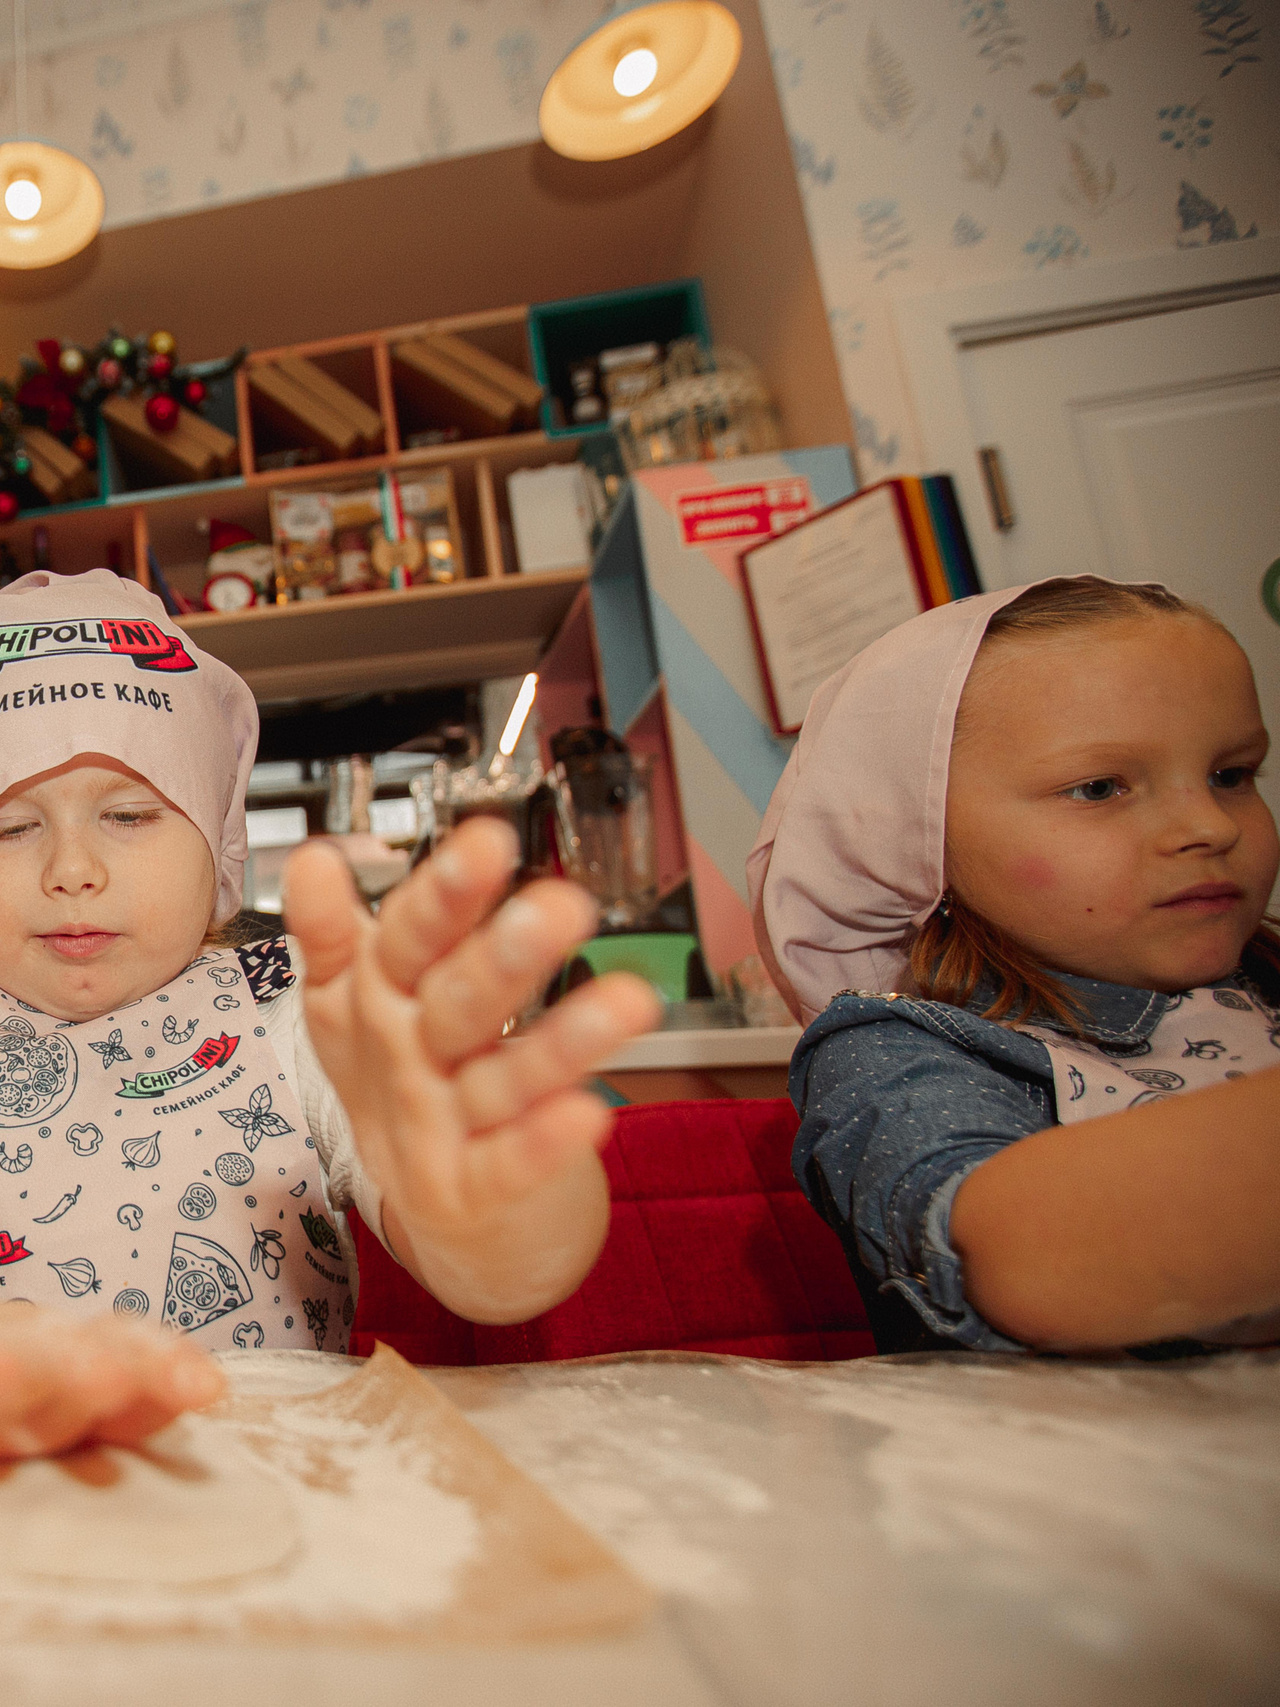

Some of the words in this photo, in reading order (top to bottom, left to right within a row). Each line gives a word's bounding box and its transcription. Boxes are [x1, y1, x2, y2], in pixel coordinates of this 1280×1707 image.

[114, 682, 173, 713] КАФЕ
[152, 1085, 221, 1115] СЕМЕЙНОЕ
[218, 1063, 246, 1090] КАФЕ
